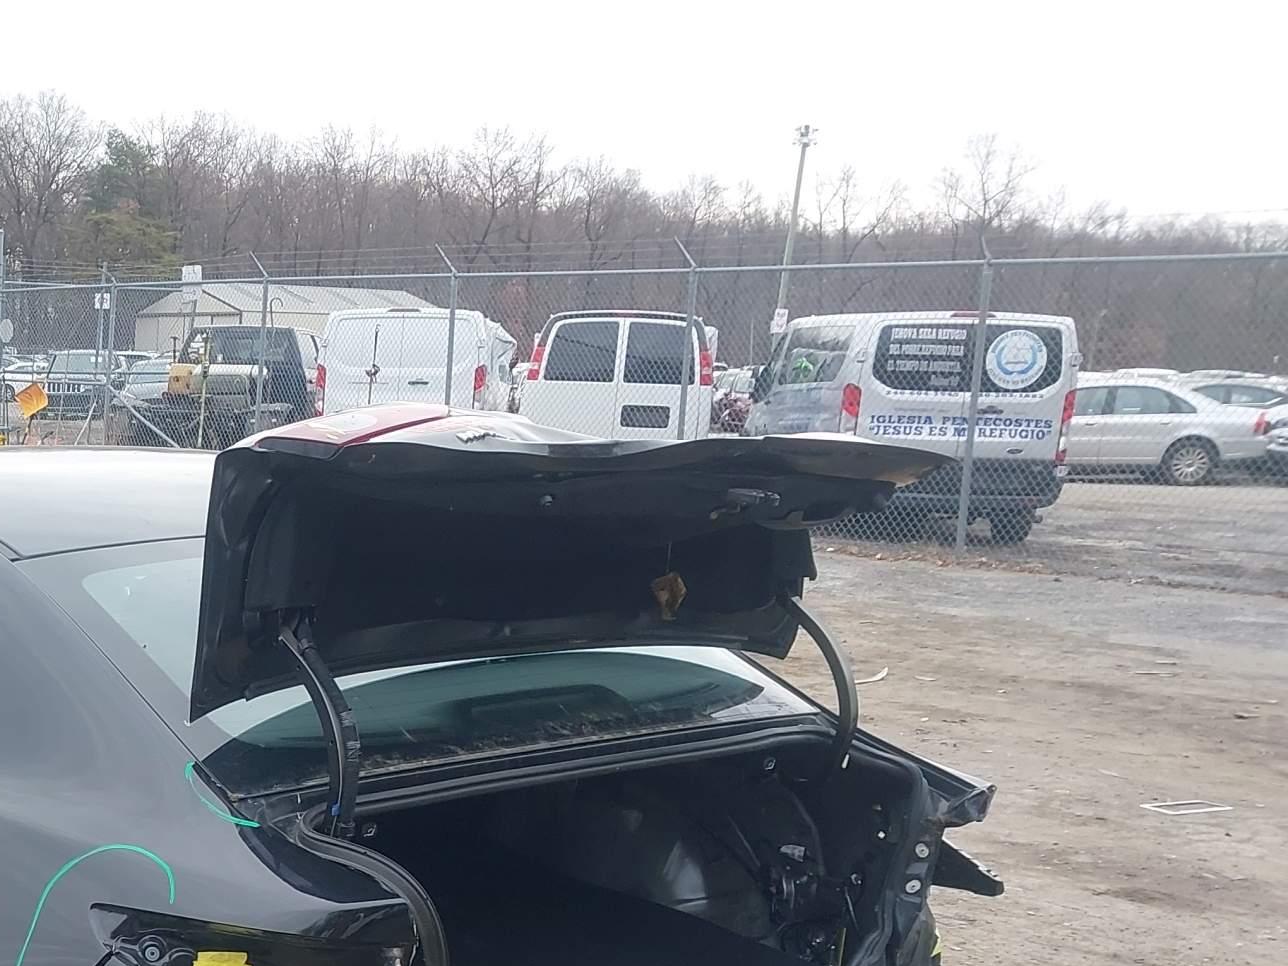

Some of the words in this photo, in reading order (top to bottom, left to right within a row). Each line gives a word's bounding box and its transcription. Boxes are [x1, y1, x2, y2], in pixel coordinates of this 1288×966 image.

[869, 415, 933, 425] IGLESIA
[929, 427, 948, 437] ES
[952, 426, 968, 437] M
